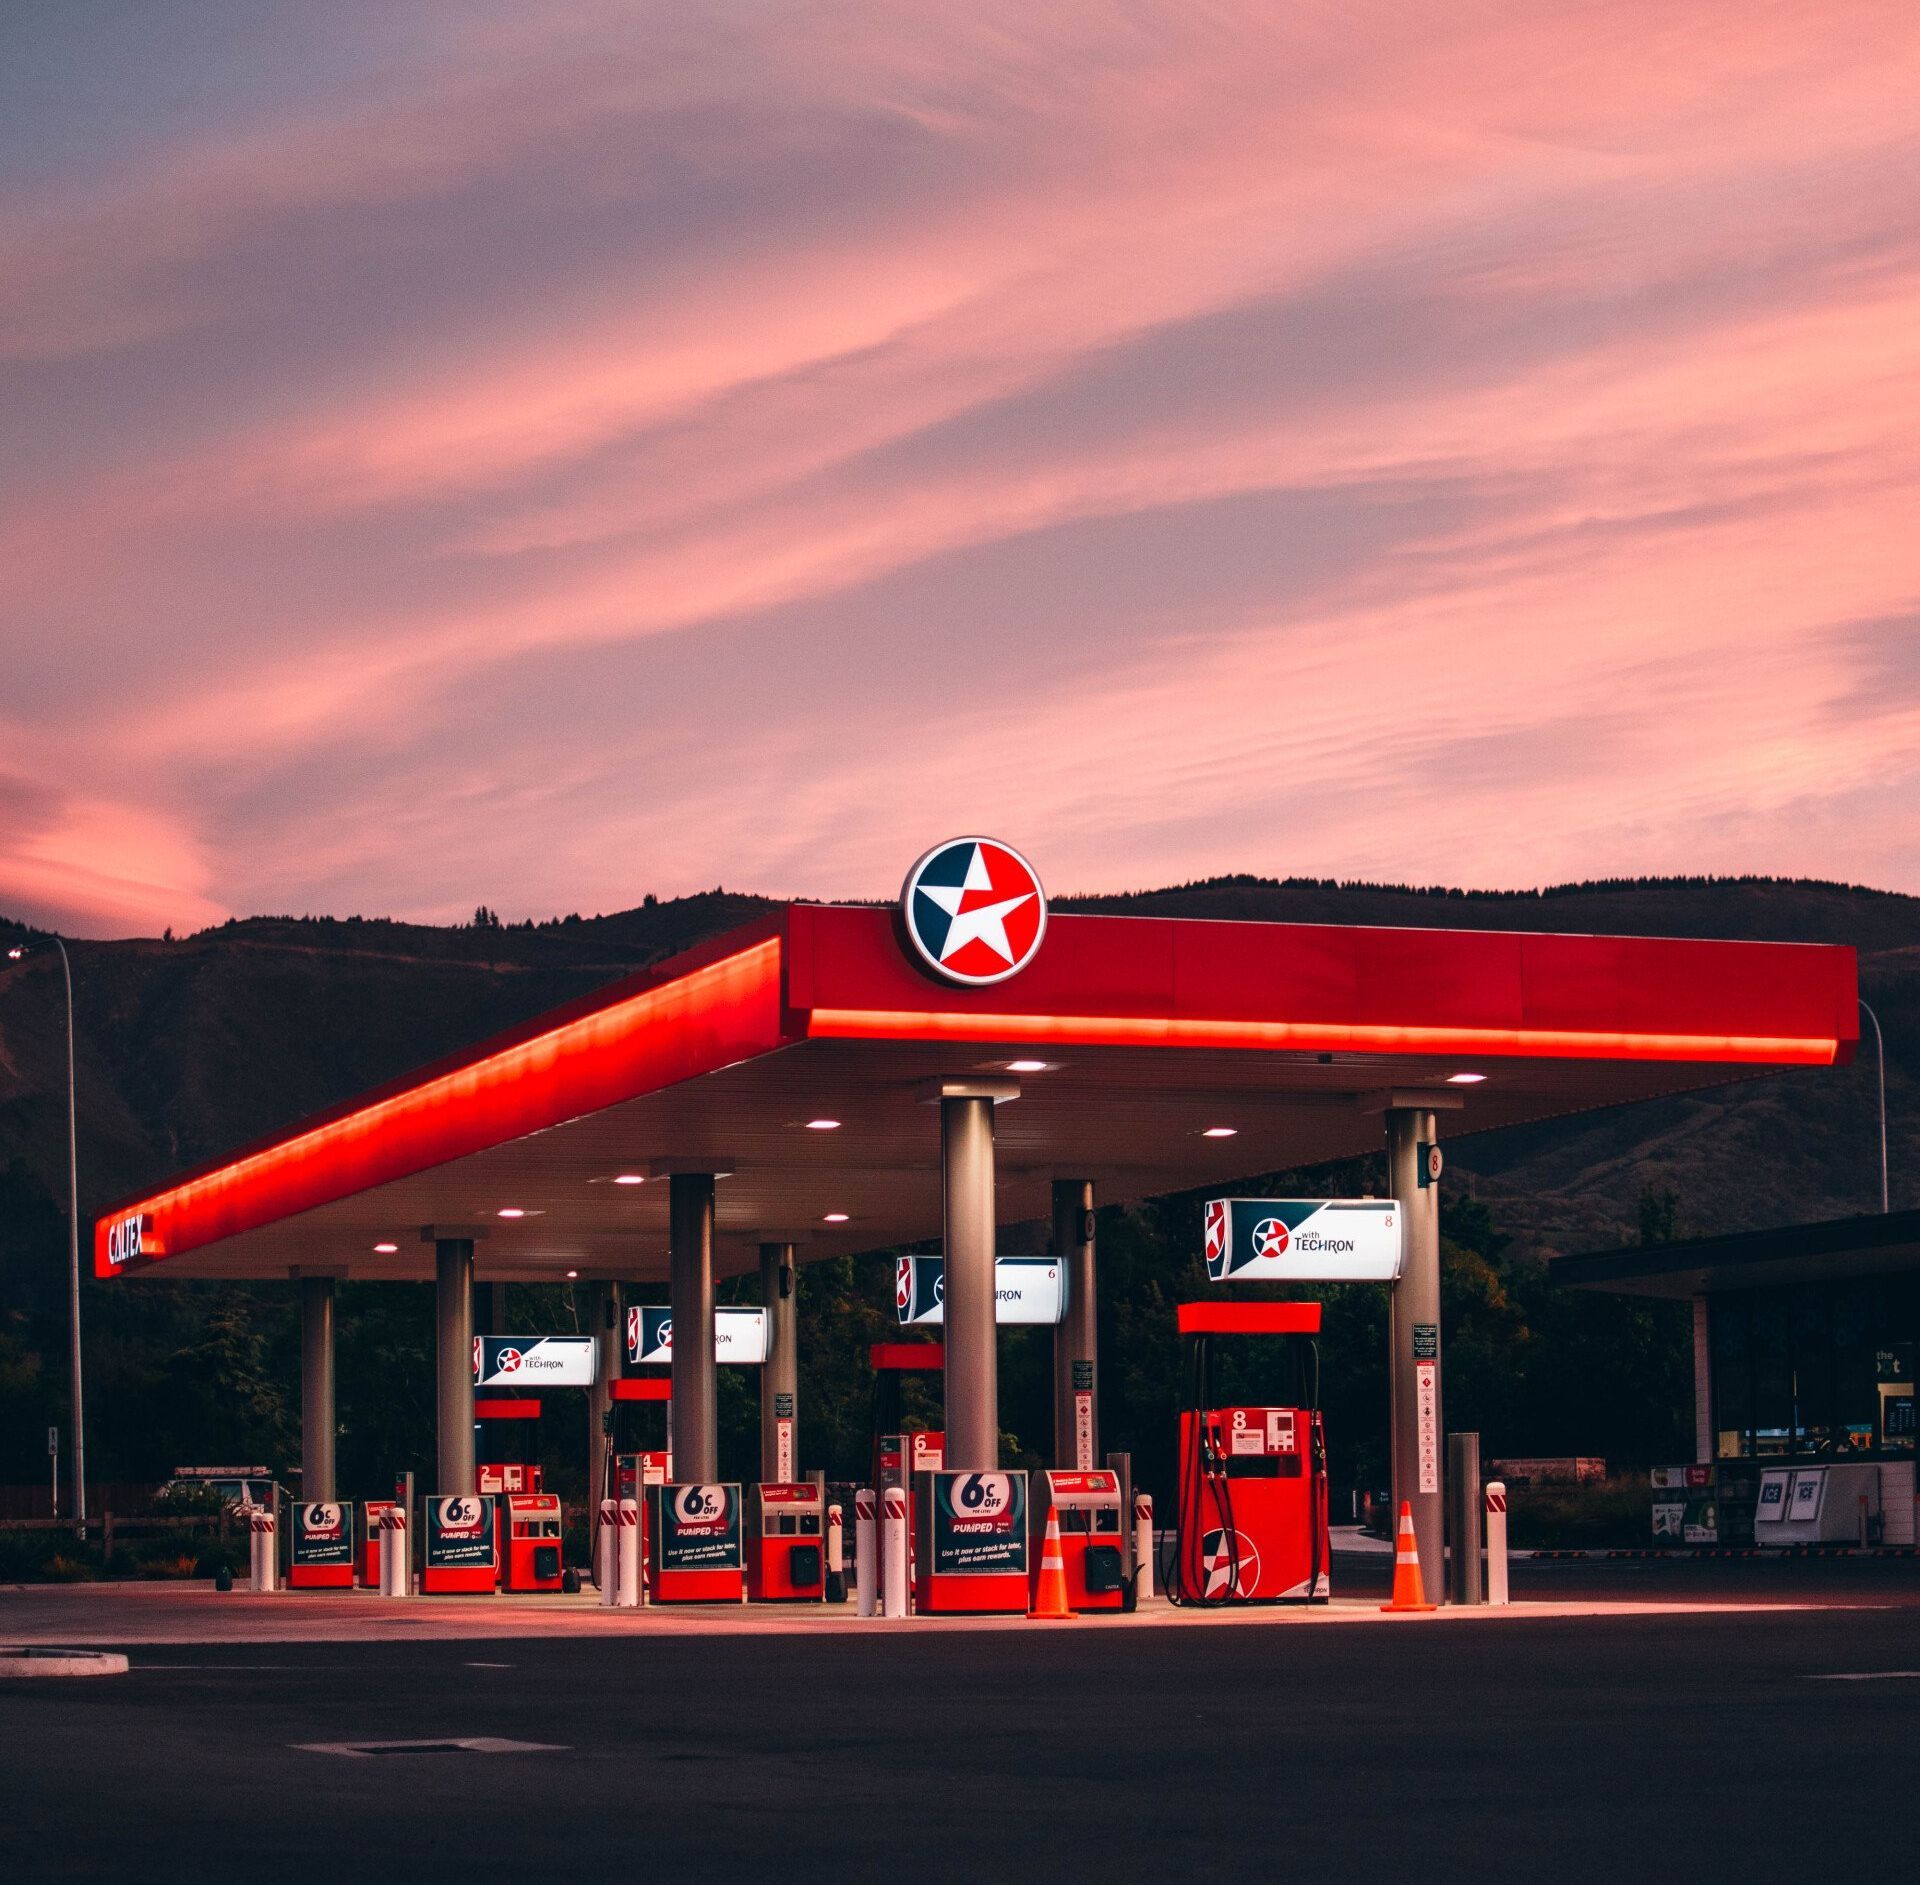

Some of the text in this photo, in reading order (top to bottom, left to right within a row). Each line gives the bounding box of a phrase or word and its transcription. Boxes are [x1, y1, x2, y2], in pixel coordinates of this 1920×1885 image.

[1433, 1155, 1438, 1171] 8
[1385, 1215, 1393, 1227] 8
[109, 1214, 143, 1264] CALTEX
[1294, 1237, 1354, 1254] TECHRON
[1048, 1269, 1056, 1279] 6
[754, 1317, 760, 1325] 4
[525, 1360, 563, 1369] TECHRON
[1233, 1411, 1246, 1430] 8
[915, 1435, 926, 1450] 6
[643, 1455, 652, 1467] 4
[481, 1466, 490, 1478] 2
[1765, 1487, 1779, 1500] ICE
[1800, 1487, 1813, 1499] ICE
[984, 1499, 1001, 1507] OFF
[677, 1527, 711, 1536] PUMPED
[953, 1522, 993, 1533] PUMPED
[440, 1531, 469, 1539] PUMPED
[941, 1549, 954, 1557] Use
[955, 1547, 960, 1555] it
[982, 1544, 998, 1552] stack
[999, 1543, 1007, 1551] for
[1008, 1542, 1022, 1550] later,
[958, 1555, 972, 1564] plus
[987, 1551, 1011, 1559] rewards.
